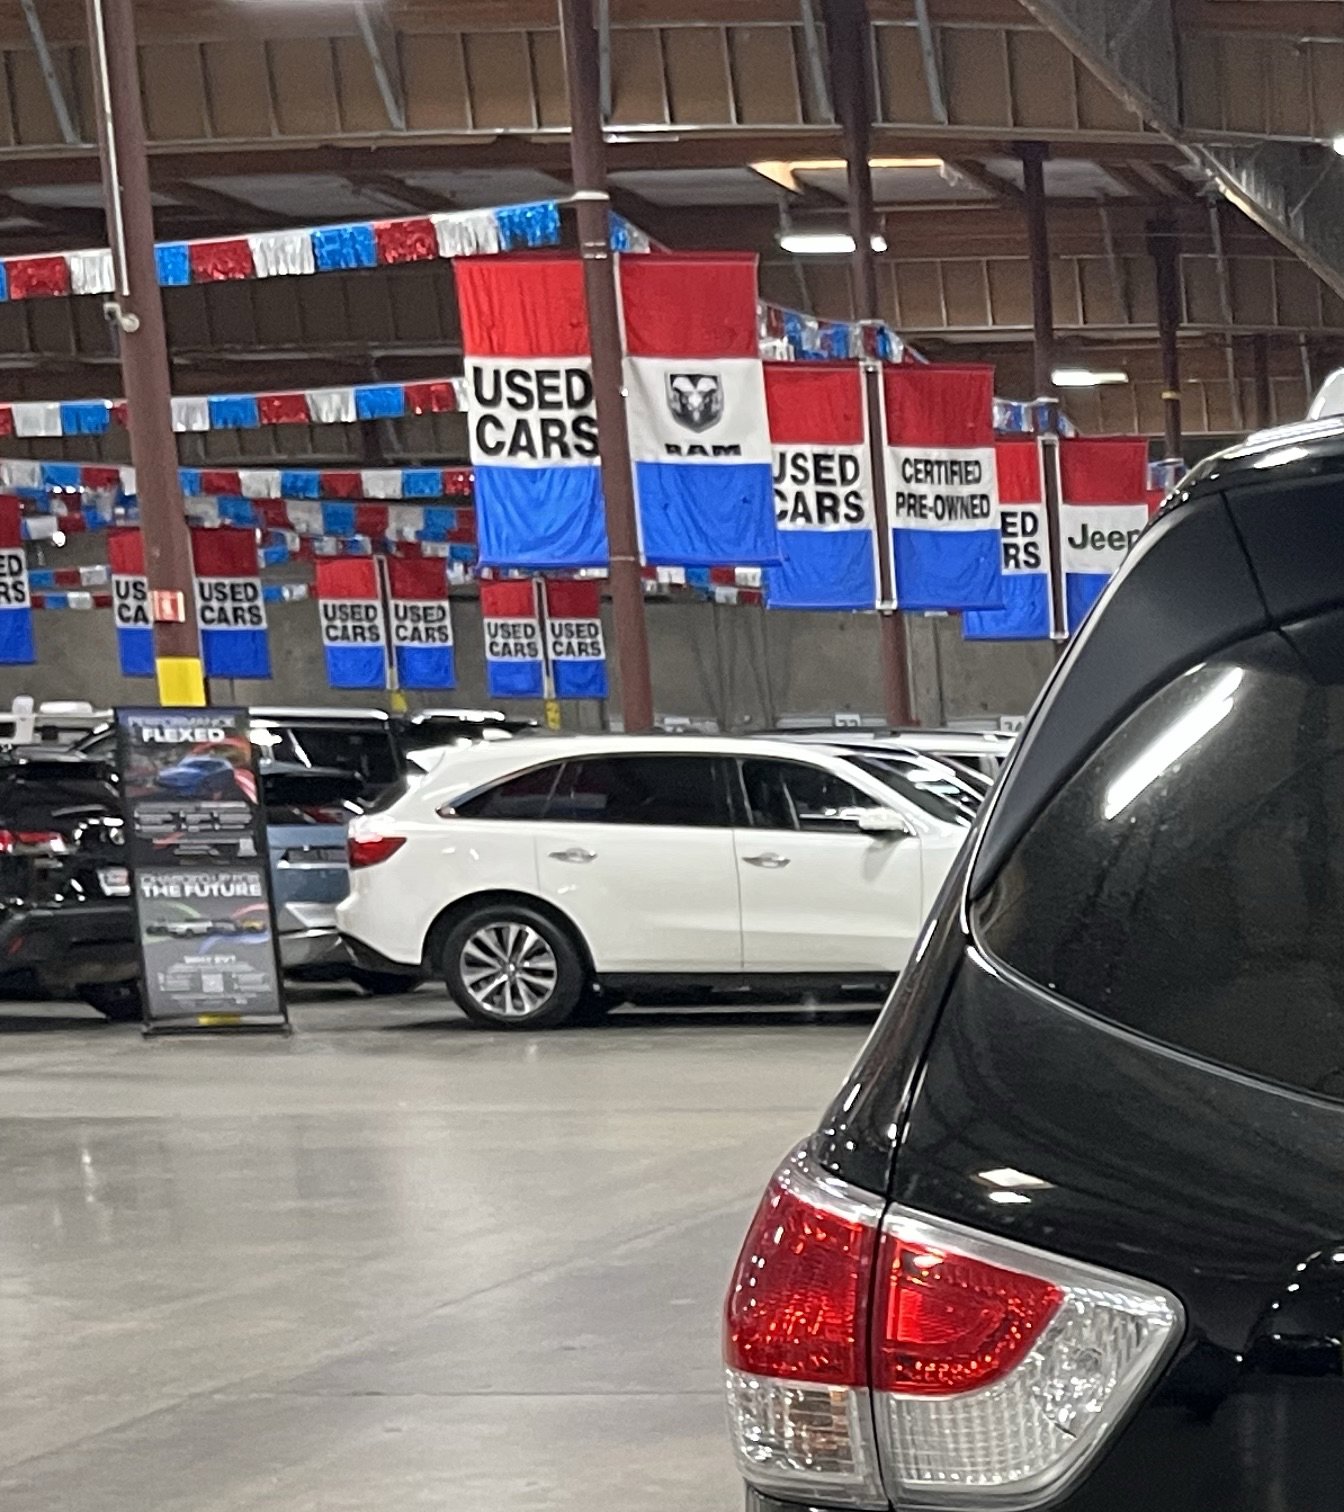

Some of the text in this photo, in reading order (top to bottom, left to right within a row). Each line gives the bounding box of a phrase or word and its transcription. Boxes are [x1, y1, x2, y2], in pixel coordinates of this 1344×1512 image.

[473, 366, 593, 411] USED
[476, 414, 599, 459] CARS
[665, 443, 742, 457] RAM
[902, 458, 982, 485] CERTIFIED
[896, 492, 991, 520] PRE-OWNED
[1001, 511, 1038, 538] ED
[0, 554, 23, 577] ED
[1003, 542, 1041, 569] RS
[0, 581, 26, 603] RS
[116, 580, 147, 600] US
[200, 581, 258, 601] USED
[117, 604, 149, 624] CA
[201, 604, 263, 626] CARS
[323, 603, 377, 622] USED
[394, 604, 446, 623] USED
[325, 624, 380, 642] CARS
[396, 624, 449, 643] CARS
[487, 622, 536, 639] USED
[552, 622, 599, 639] USED
[489, 641, 538, 658] CARS
[552, 640, 601, 657] CARS
[142, 728, 225, 742] FLEXED
[143, 882, 261, 897] THE FUTURE
